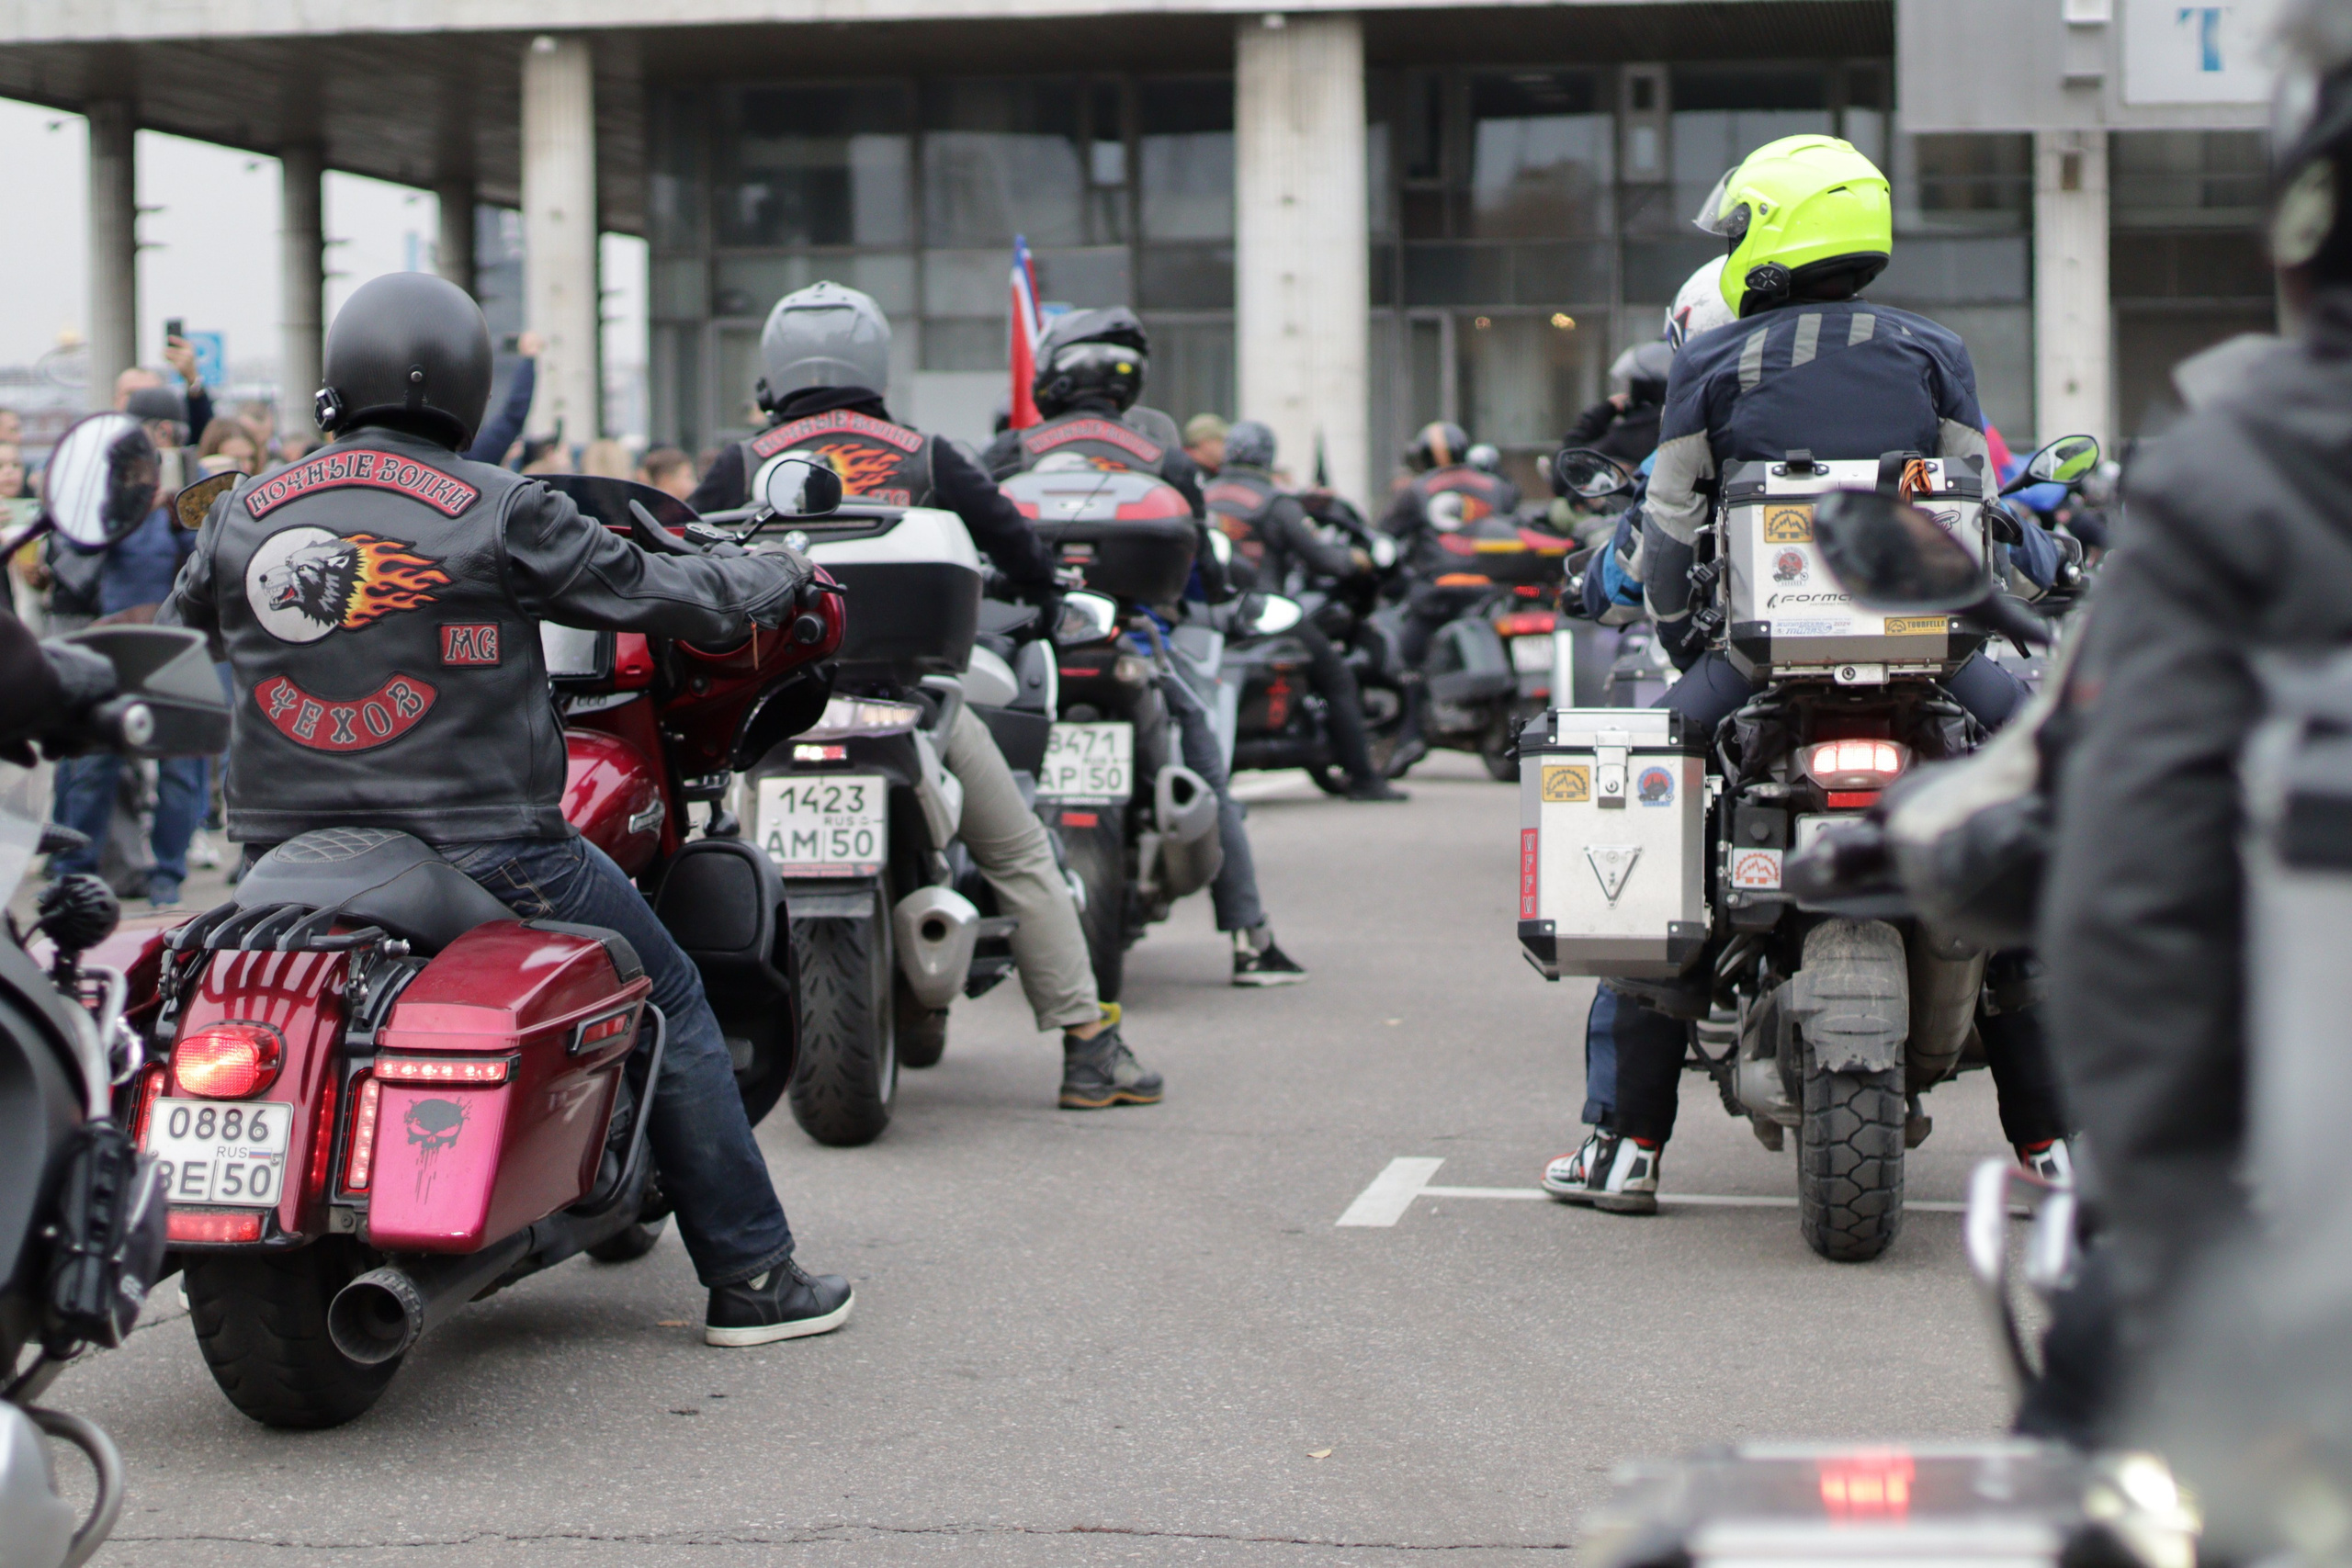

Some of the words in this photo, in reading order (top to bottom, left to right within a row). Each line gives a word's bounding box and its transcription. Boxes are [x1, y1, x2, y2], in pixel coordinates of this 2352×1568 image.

[248, 453, 374, 513] НОЧНЫЕ
[375, 457, 473, 512] ВОЛКИ
[269, 679, 424, 744] ЧЕХОВ
[1090, 767, 1122, 790] 50
[779, 785, 865, 814] 1423
[823, 816, 854, 826] RUS
[831, 829, 873, 857] 50
[168, 1106, 269, 1143] 0886
[216, 1145, 248, 1158] RUS
[221, 1162, 272, 1197] 50
